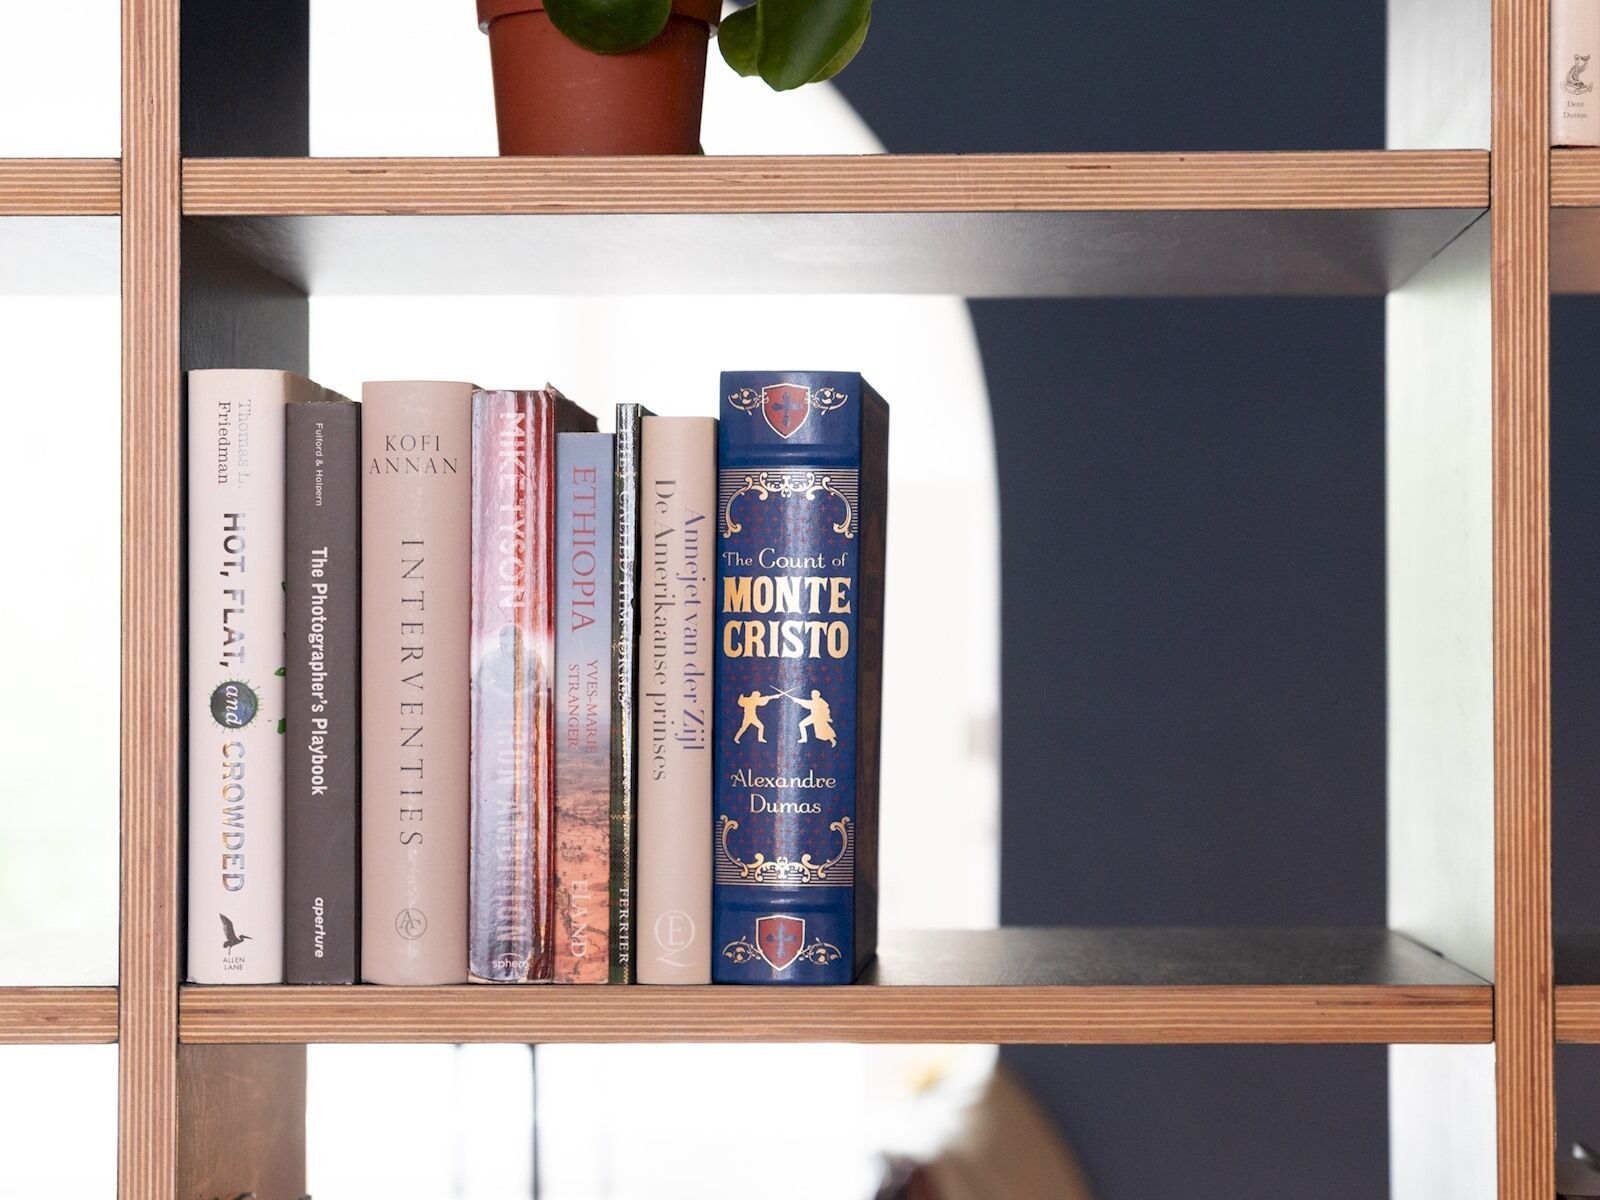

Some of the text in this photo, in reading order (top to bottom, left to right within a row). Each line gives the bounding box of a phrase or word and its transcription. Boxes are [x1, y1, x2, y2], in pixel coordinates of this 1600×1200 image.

[218, 401, 231, 484] Friedman
[238, 399, 251, 467] Thomas
[315, 422, 324, 506] Fulford & Halpern
[369, 458, 458, 475] ANNAN
[385, 434, 441, 452] KOFI
[499, 412, 526, 608] MIKE TYSON
[572, 465, 597, 632] ETHIOPIA
[722, 547, 849, 569] The Count of
[722, 576, 852, 615] MONTE
[646, 480, 676, 781] De Amerikaanse prinses
[674, 506, 706, 749] Annejet van der Zijl
[722, 620, 849, 659] CRISTO
[219, 513, 246, 892] HOT, FLAT, and CROWDED
[308, 547, 328, 796] The Photographer's Playbook
[400, 540, 424, 846] INTERVENTIES
[567, 664, 580, 749] STRANGER
[585, 660, 598, 753] YVES-MARIE
[730, 768, 836, 789] Alexandre
[750, 793, 822, 814] Dumas
[313, 897, 324, 958] aperture
[571, 880, 591, 957] ELAND
[619, 888, 630, 964] FERRIER
[492, 958, 529, 969] sphere
